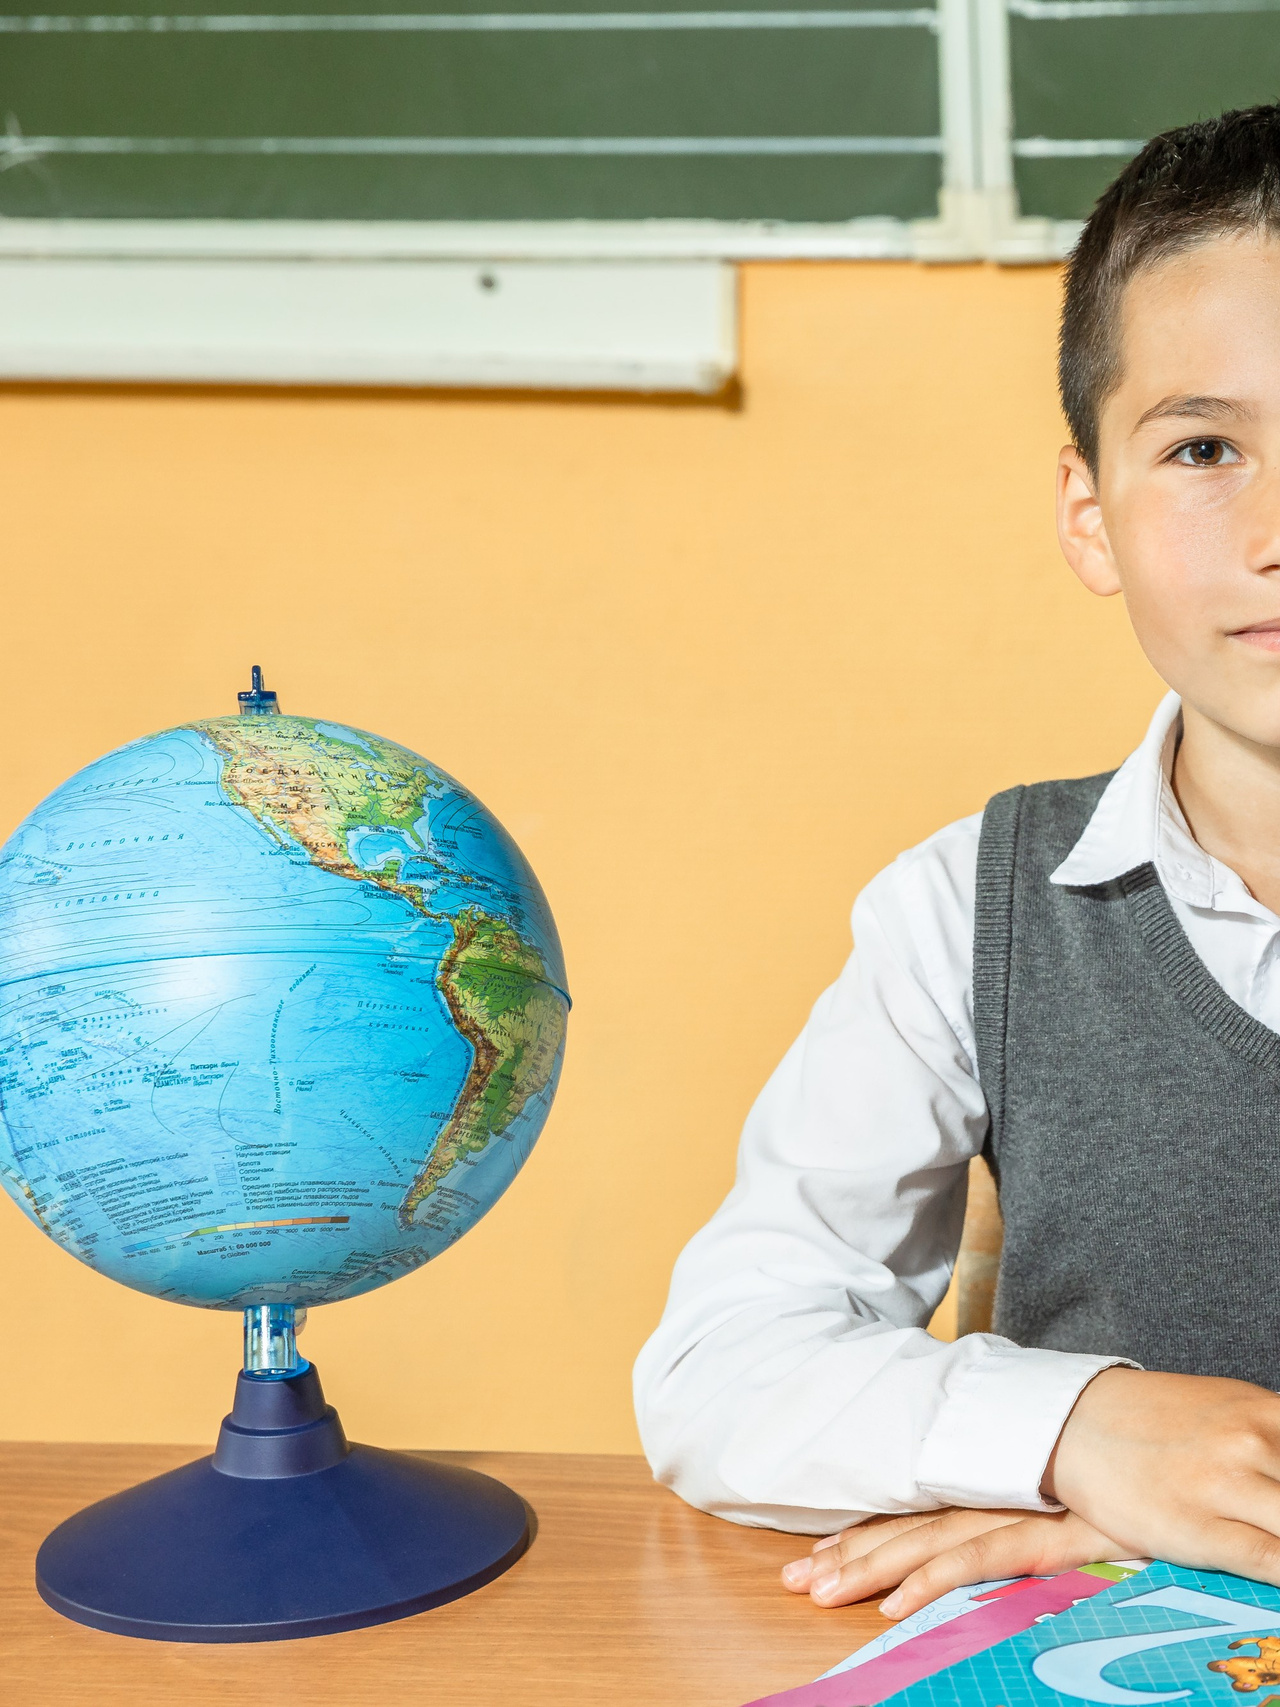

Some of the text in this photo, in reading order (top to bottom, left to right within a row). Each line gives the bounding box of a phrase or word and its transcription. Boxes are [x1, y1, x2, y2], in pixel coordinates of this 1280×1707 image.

[82, 777, 173, 793] Северо-
[289, 785, 356, 796] ШТАТЫ
[265, 802, 357, 813] АМЕРИКИ
[66, 833, 185, 851] Восточная
[54, 890, 160, 909] котловина
[289, 963, 317, 993] поднятие
[357, 1001, 423, 1012] Перуанская
[368, 1021, 430, 1033] котловина
[340, 1109, 375, 1141] Чилийское
[65, 1127, 106, 1142] котловина
[236, 1149, 291, 1158] Научные станции
[237, 1160, 261, 1168] Болота
[378, 1145, 404, 1178] поднятие
[239, 1167, 275, 1175] Солончаки
[242, 1182, 271, 1191] Средние
[272, 1181, 299, 1189] границы
[248, 1189, 273, 1197] период
[274, 1187, 316, 1195] наибольшего
[244, 1197, 273, 1205] Средние
[274, 1195, 302, 1203] границы
[303, 1193, 340, 1201] плавающих
[251, 1203, 276, 1211] период
[276, 1201, 319, 1209] наименьшего
[197, 1245, 227, 1256] Масштаб
[226, 1251, 250, 1259] Globen
